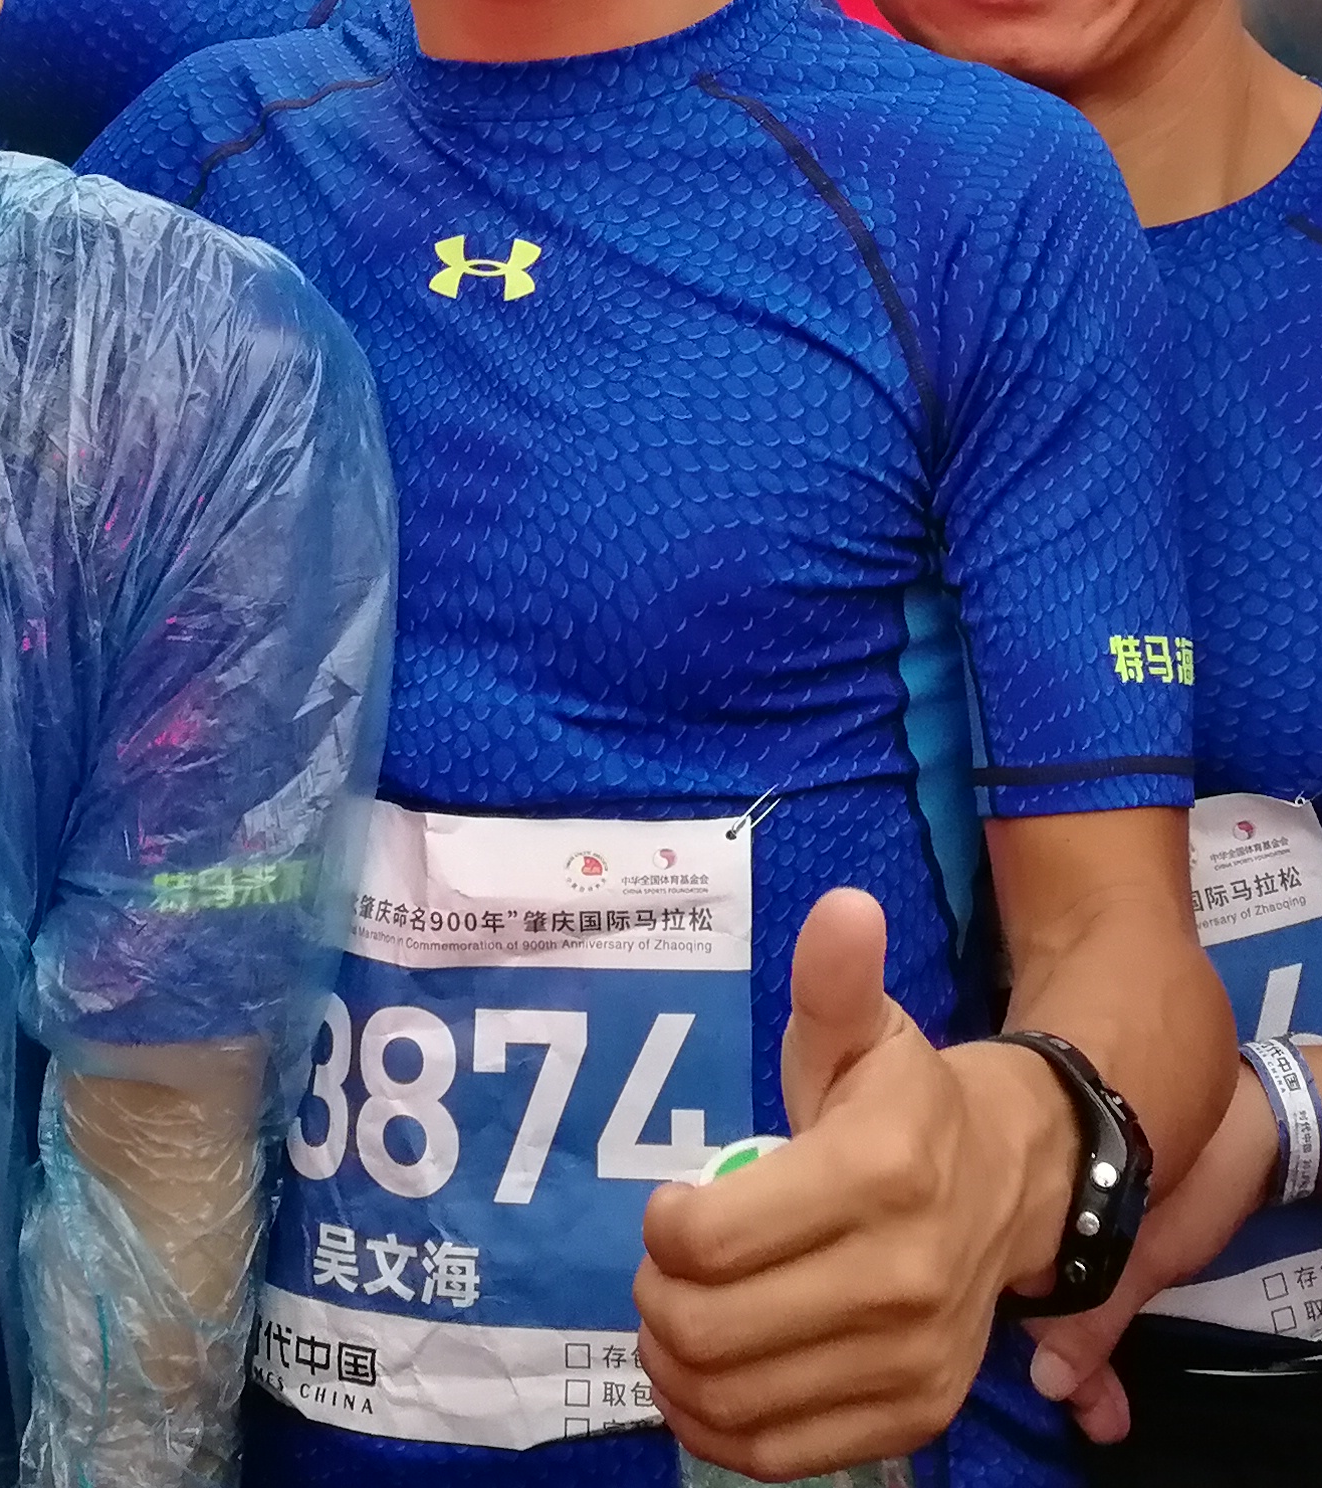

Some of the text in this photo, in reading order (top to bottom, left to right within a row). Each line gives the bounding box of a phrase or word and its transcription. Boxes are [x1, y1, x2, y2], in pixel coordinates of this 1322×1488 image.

[1241, 907, 1251, 920] of
[1255, 895, 1307, 916] Zhaoqing
[406, 937, 503, 952] Commemoration
[506, 940, 520, 951] of
[522, 939, 557, 951] 900th
[562, 938, 634, 952] Anniversary
[639, 939, 651, 951] of
[654, 938, 713, 954] Zhaoqing
[1261, 1042, 1301, 1092] 代中国
[312, 1222, 480, 1309] 吴文海
[299, 1383, 373, 1414] CHINA
[602, 1380, 654, 1407] 取包
